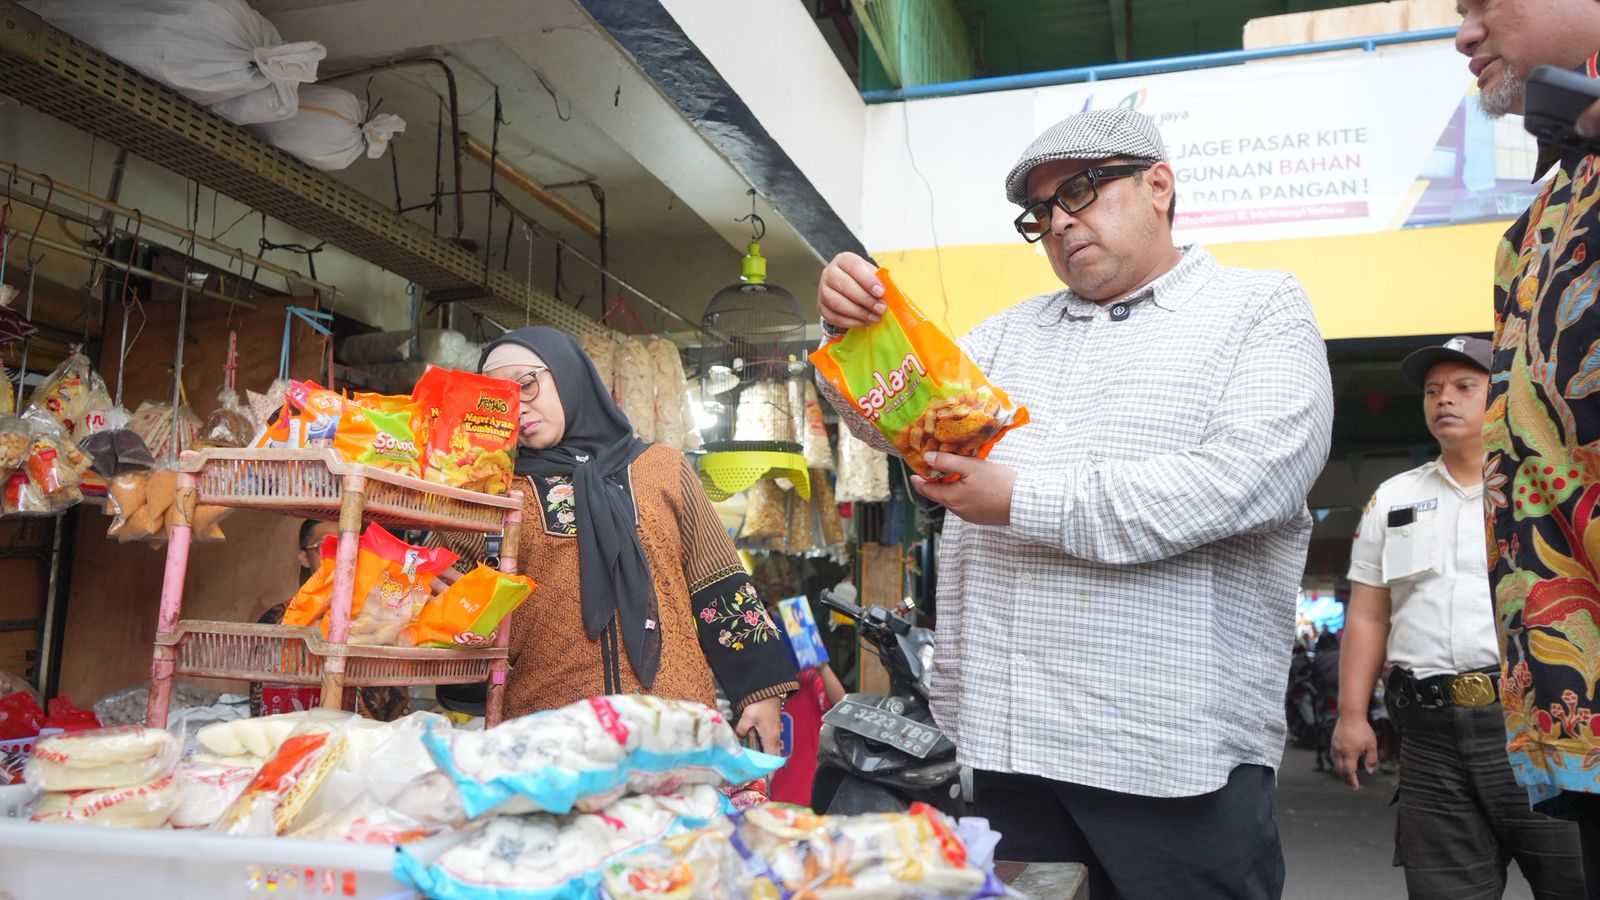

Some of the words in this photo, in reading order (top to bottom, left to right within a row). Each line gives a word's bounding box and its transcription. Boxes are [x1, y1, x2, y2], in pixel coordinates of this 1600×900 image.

[1176, 139, 1233, 159] JAGE
[1238, 132, 1310, 153] PASAR
[1316, 127, 1368, 147] KITE
[1175, 161, 1273, 183] GUNAAN
[1279, 153, 1361, 176] BAHAN
[1193, 188, 1254, 205] PADA
[1259, 178, 1357, 201] PANGAN
[858, 353, 928, 421] salam
[838, 703, 853, 715] B
[854, 708, 897, 729] 3223
